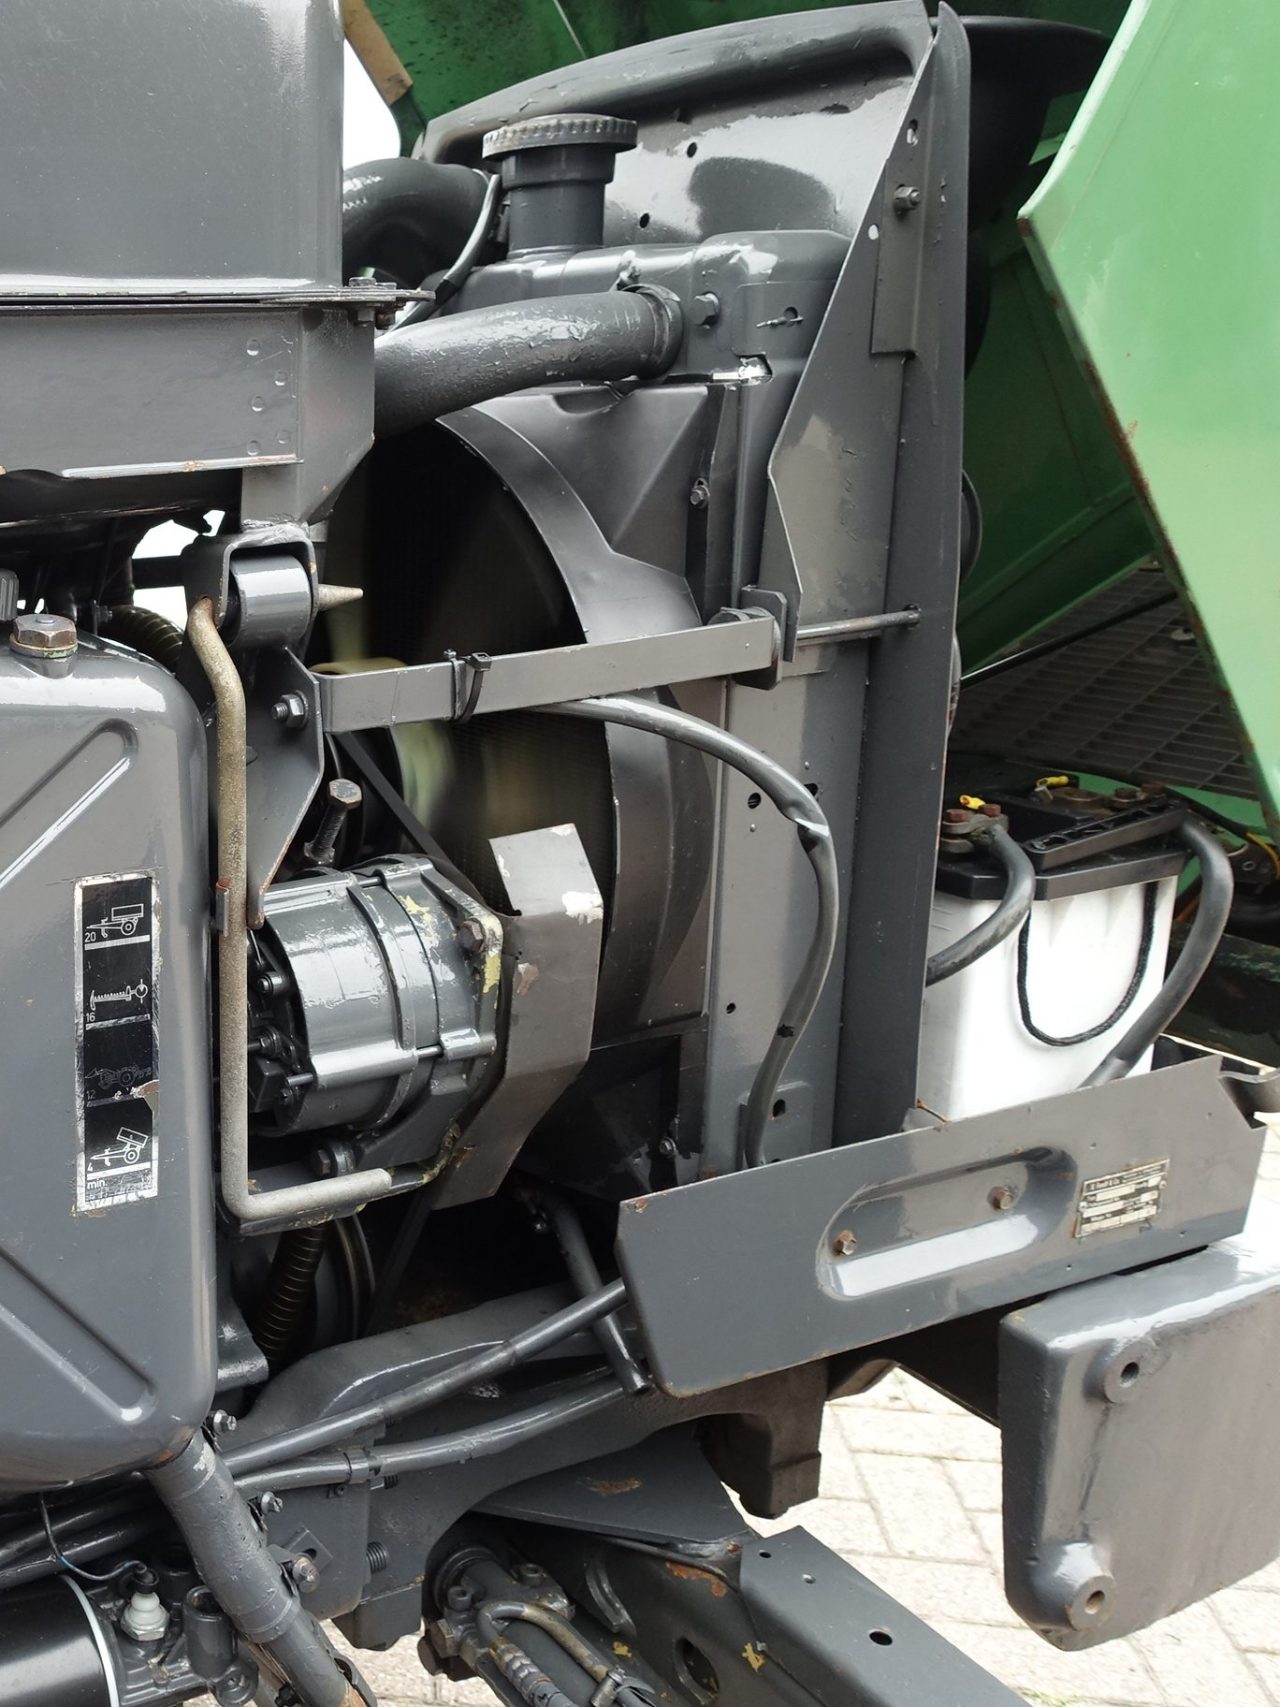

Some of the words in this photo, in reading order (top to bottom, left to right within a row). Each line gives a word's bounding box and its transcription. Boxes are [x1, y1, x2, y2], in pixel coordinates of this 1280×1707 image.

[84, 931, 97, 943] 20
[86, 1012, 96, 1023] 16
[86, 1090, 96, 1101] 12
[87, 1162, 93, 1172] 4
